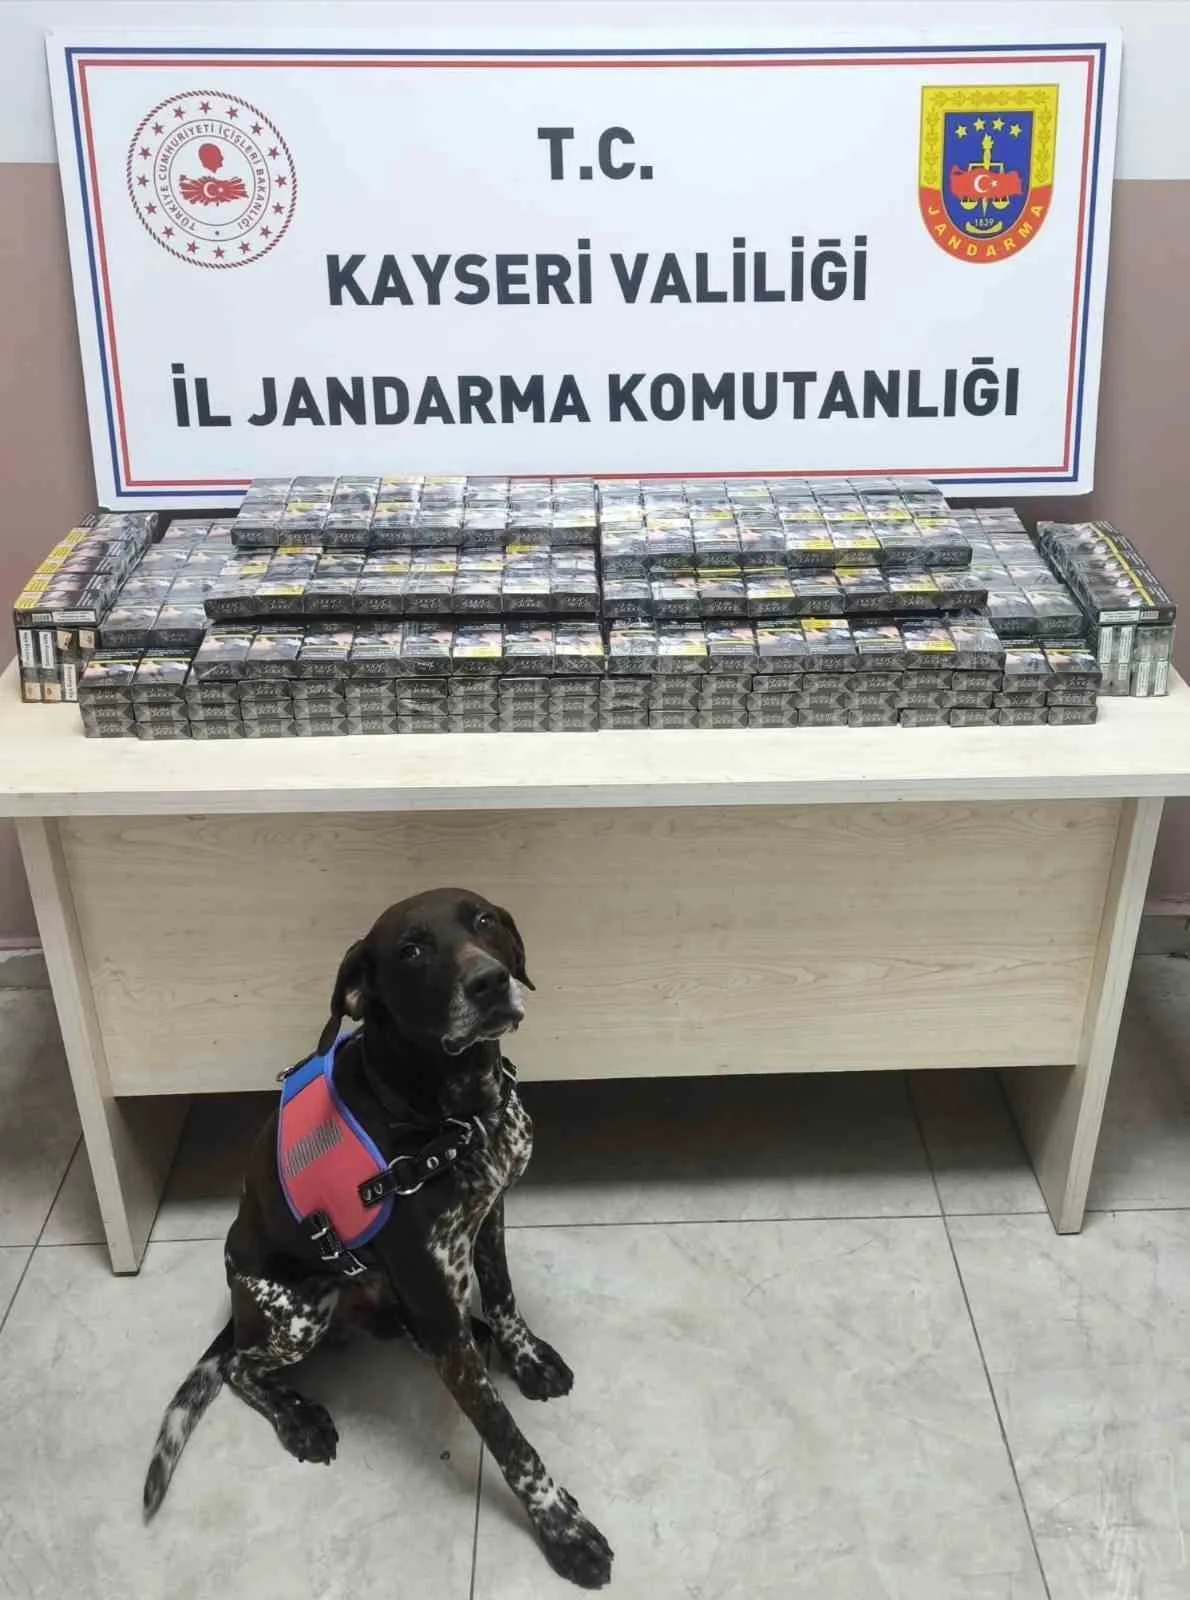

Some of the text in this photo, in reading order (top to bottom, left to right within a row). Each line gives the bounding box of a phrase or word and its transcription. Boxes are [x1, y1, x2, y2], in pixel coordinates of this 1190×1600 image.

[158, 123, 266, 231] TÜRKİYE CUMHURİYETİ İÇİŞLERİ BAKANLIĞI
[538, 127, 653, 181] T.C.
[927, 204, 1044, 257] JANDARMA
[326, 235, 868, 306] KAYSERİ VALİLİĞİ
[171, 357, 1019, 427] İL JANDARMA KOMUTANLIĞI
